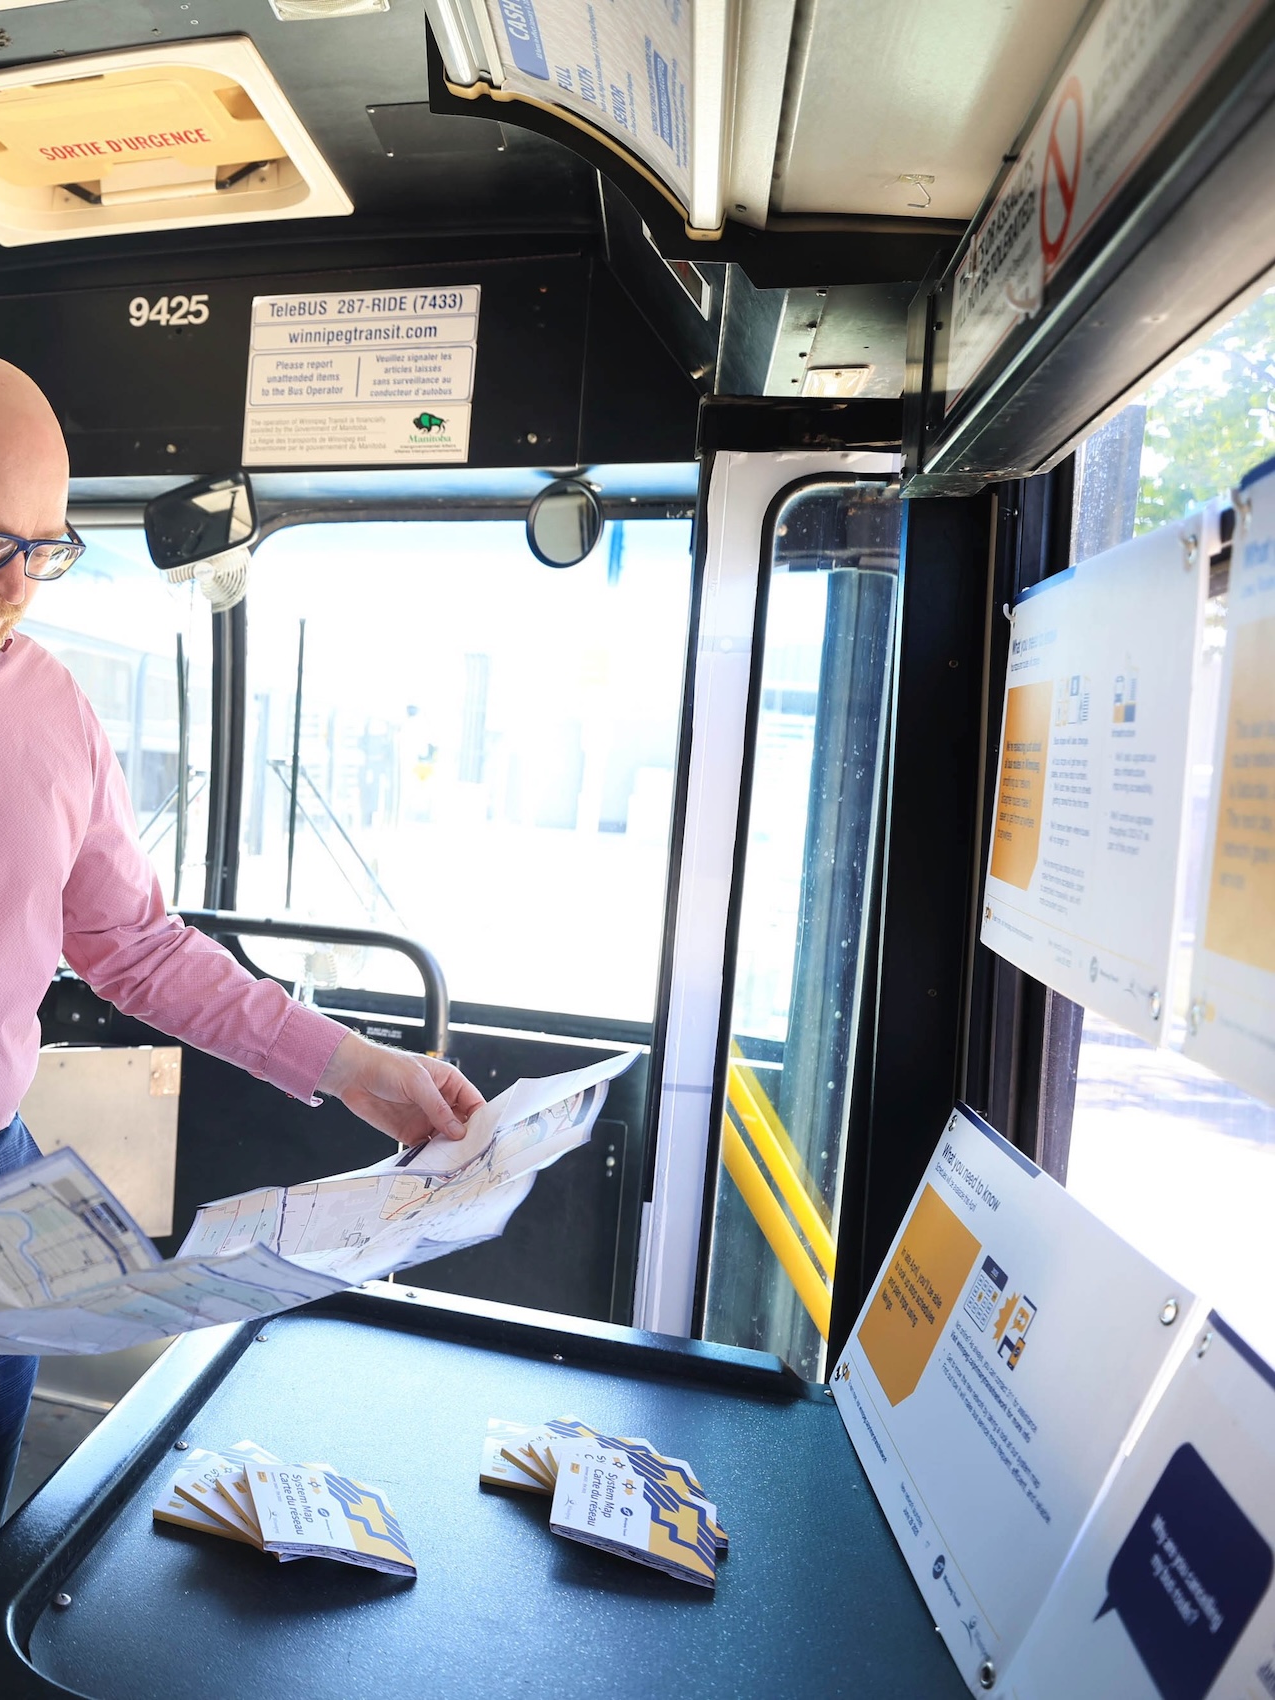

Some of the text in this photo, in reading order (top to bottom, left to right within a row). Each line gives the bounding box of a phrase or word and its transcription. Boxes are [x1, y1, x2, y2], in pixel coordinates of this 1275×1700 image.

[503, 0, 530, 41] CASH
[555, 65, 574, 93] FULL
[576, 64, 597, 105] YOUTH
[610, 83, 628, 130] SENIOR
[39, 128, 212, 161] SORTIE D'URGENCE
[128, 294, 210, 327] 9425
[270, 293, 463, 317] TeleBUS 287-RIDE (7433)
[289, 326, 437, 344] winnipegtransit.com
[276, 360, 333, 370] Please report
[376, 355, 405, 363] Veuillez
[407, 353, 438, 363] signaler
[384, 366, 412, 374] articles
[262, 386, 343, 397] to the Bus Operator
[267, 373, 340, 383] unattended items
[393, 377, 439, 385] surveillance
[370, 389, 412, 397] conducteur
[409, 434, 451, 443] Manitoba
[942, 1143, 1000, 1212] What you need to know
[279, 1472, 305, 1535] Carte du réseau
[291, 1474, 314, 1523] System Map
[587, 1469, 604, 1527] Carte du réseau
[601, 1472, 619, 1518] System Map
